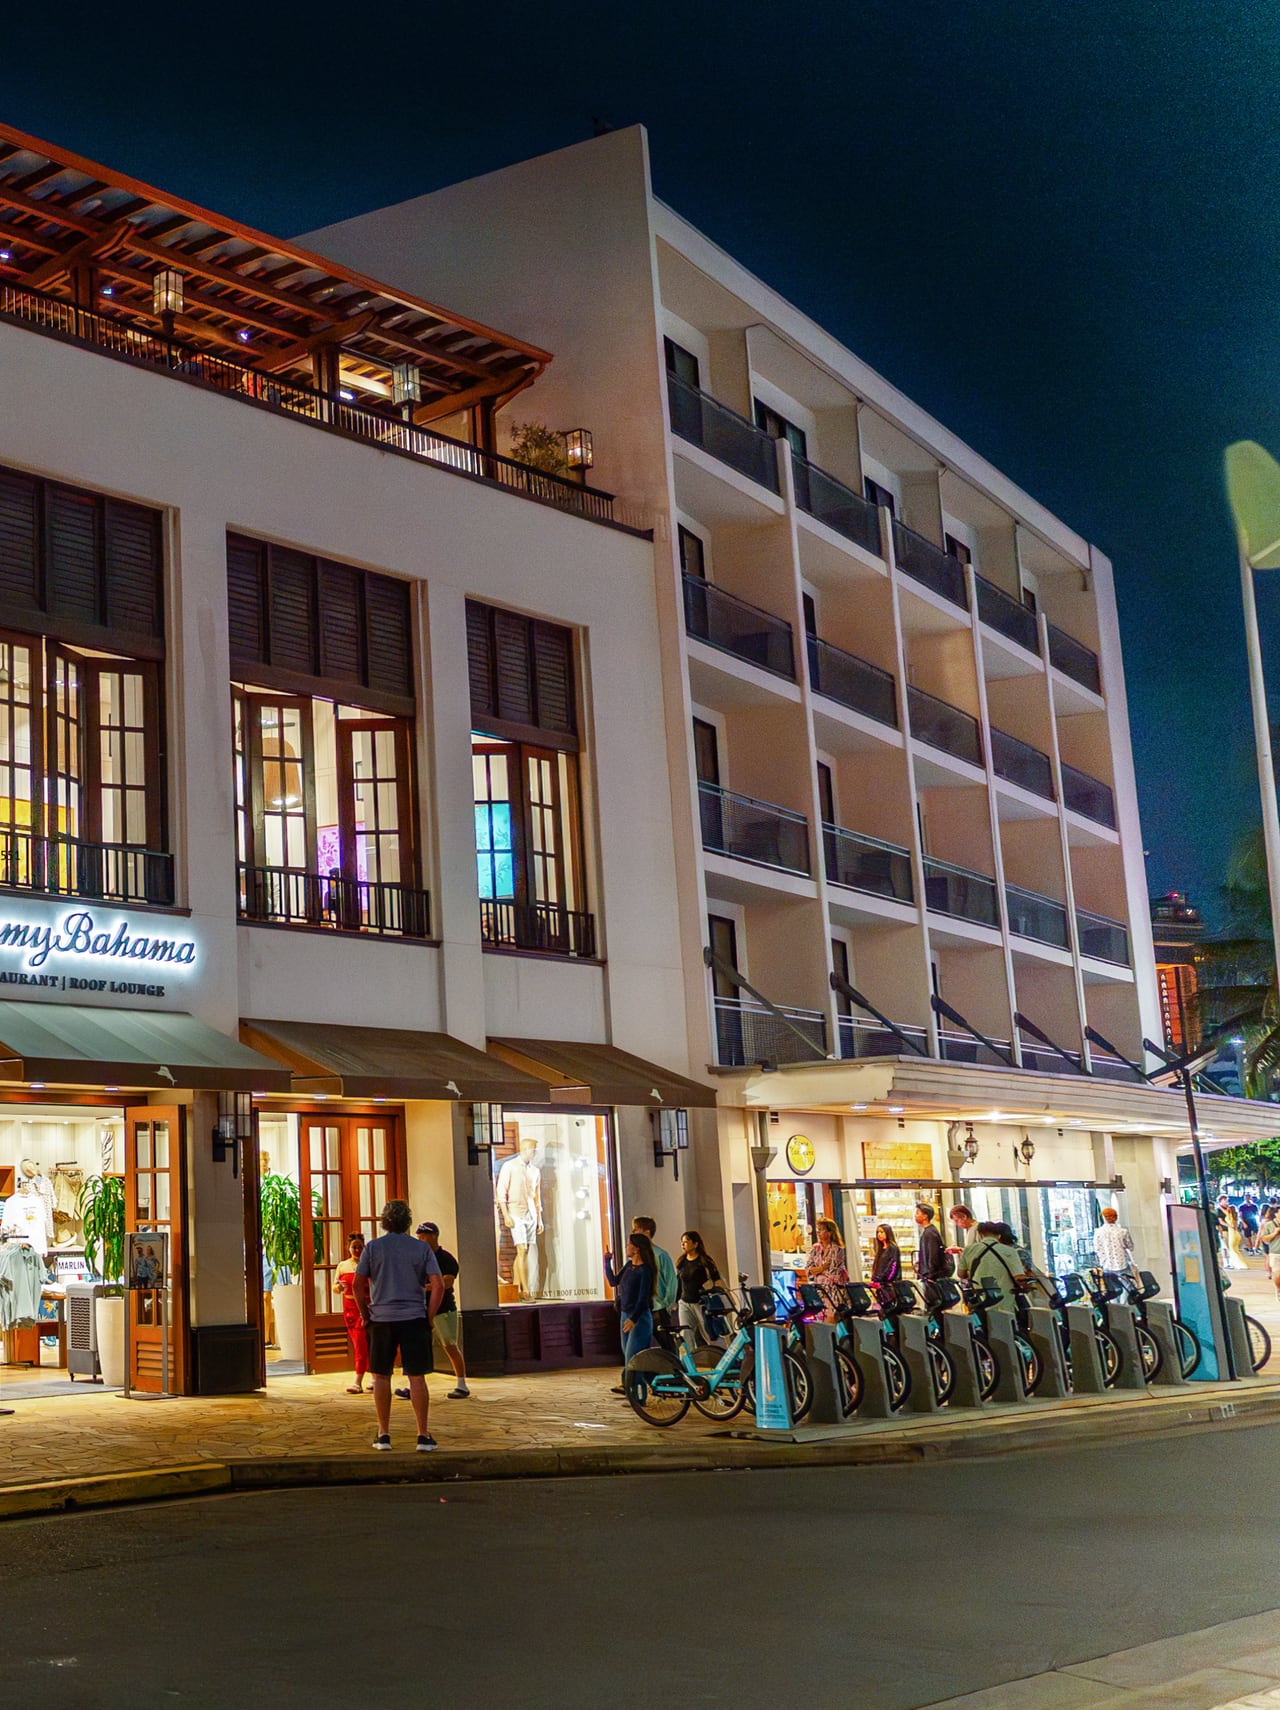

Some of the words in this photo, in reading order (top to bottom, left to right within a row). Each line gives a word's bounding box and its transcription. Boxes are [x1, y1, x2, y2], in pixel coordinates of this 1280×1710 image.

[53, 912, 196, 964] Bahama
[69, 976, 107, 990] ROOF
[110, 980, 165, 997] LOUNGE
[58, 1261, 85, 1270] MARLIN
[573, 1288, 597, 1296] LOUNGE
